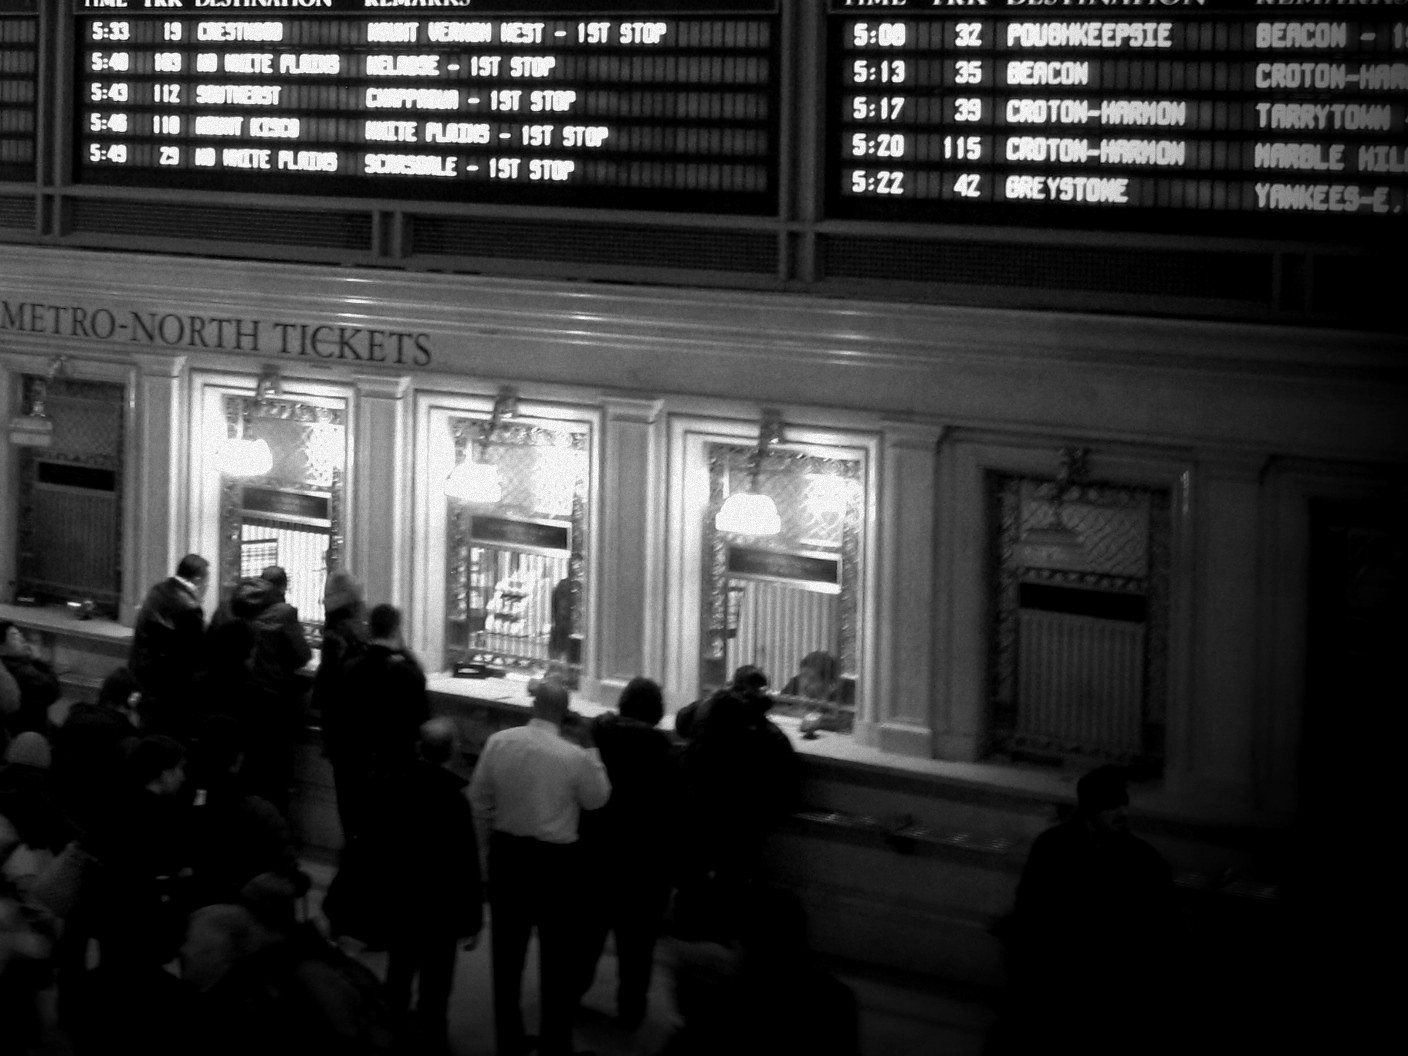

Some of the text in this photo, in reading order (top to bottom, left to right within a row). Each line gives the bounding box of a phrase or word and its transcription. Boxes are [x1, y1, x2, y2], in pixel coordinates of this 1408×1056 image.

[92, 21, 131, 41] 5:33
[577, 21, 611, 44] 1ST
[619, 21, 667, 44] STOP
[954, 21, 983, 48] 32
[1006, 21, 1173, 48] POUGHKEEPSIE
[1255, 22, 1347, 49] BEACON
[470, 55, 502, 77] 1ST
[510, 55, 556, 78] STOP
[853, 59, 1408, 90] 5:13 35 BEACON CROTON-HAR
[490, 89, 523, 112] 1ST
[530, 89, 577, 112] STOP
[852, 95, 1391, 131] 5:17 39 CROTON-HARMON TARRYTOWN
[521, 124, 555, 147] 1ST
[562, 125, 609, 148] STOP
[851, 132, 1408, 172] 5:20 115 CROTON-HARMON MARBLE HIL
[489, 157, 522, 179] 1ST
[528, 158, 575, 181] STOP
[851, 169, 1408, 213] 5:22 42 GREYSTONE YANKEES-E.
[272, 322, 434, 367] TICKETS
